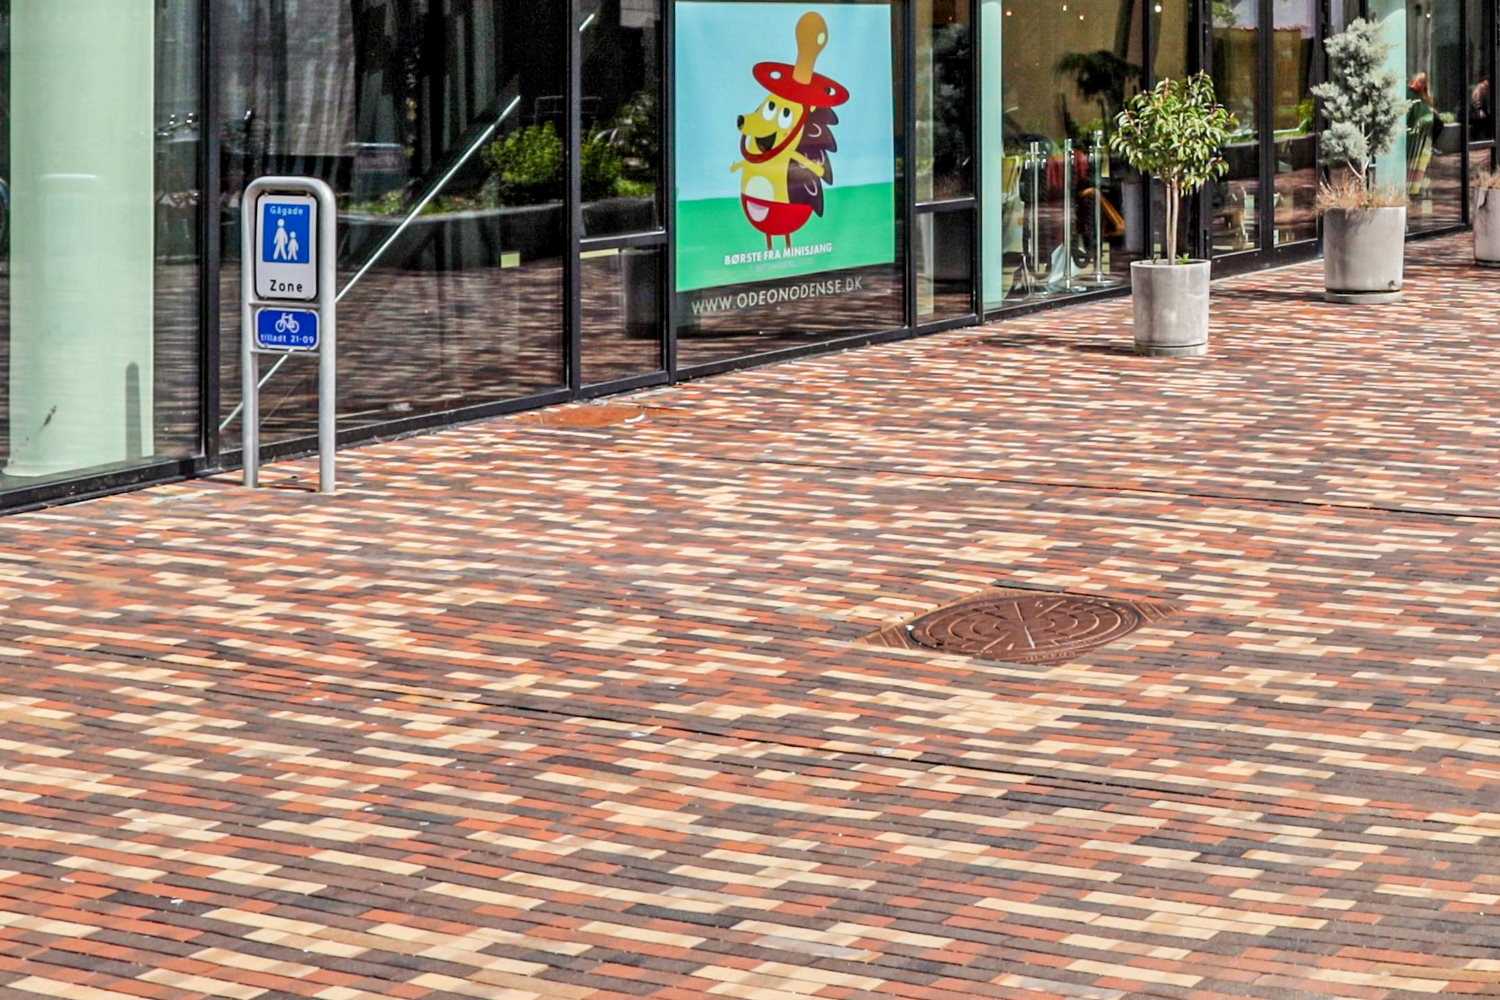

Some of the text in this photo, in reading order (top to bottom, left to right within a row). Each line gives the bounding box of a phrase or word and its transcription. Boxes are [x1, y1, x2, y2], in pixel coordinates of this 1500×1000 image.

[270, 206, 304, 216] Gågade
[724, 251, 762, 266] BØRSTE
[763, 249, 781, 260] FRA
[783, 242, 833, 258] MINISJANG
[270, 279, 303, 293] Zone
[691, 276, 863, 315] WWW.ODEONODENSE.DK
[261, 333, 315, 344] tilladt 21-09
